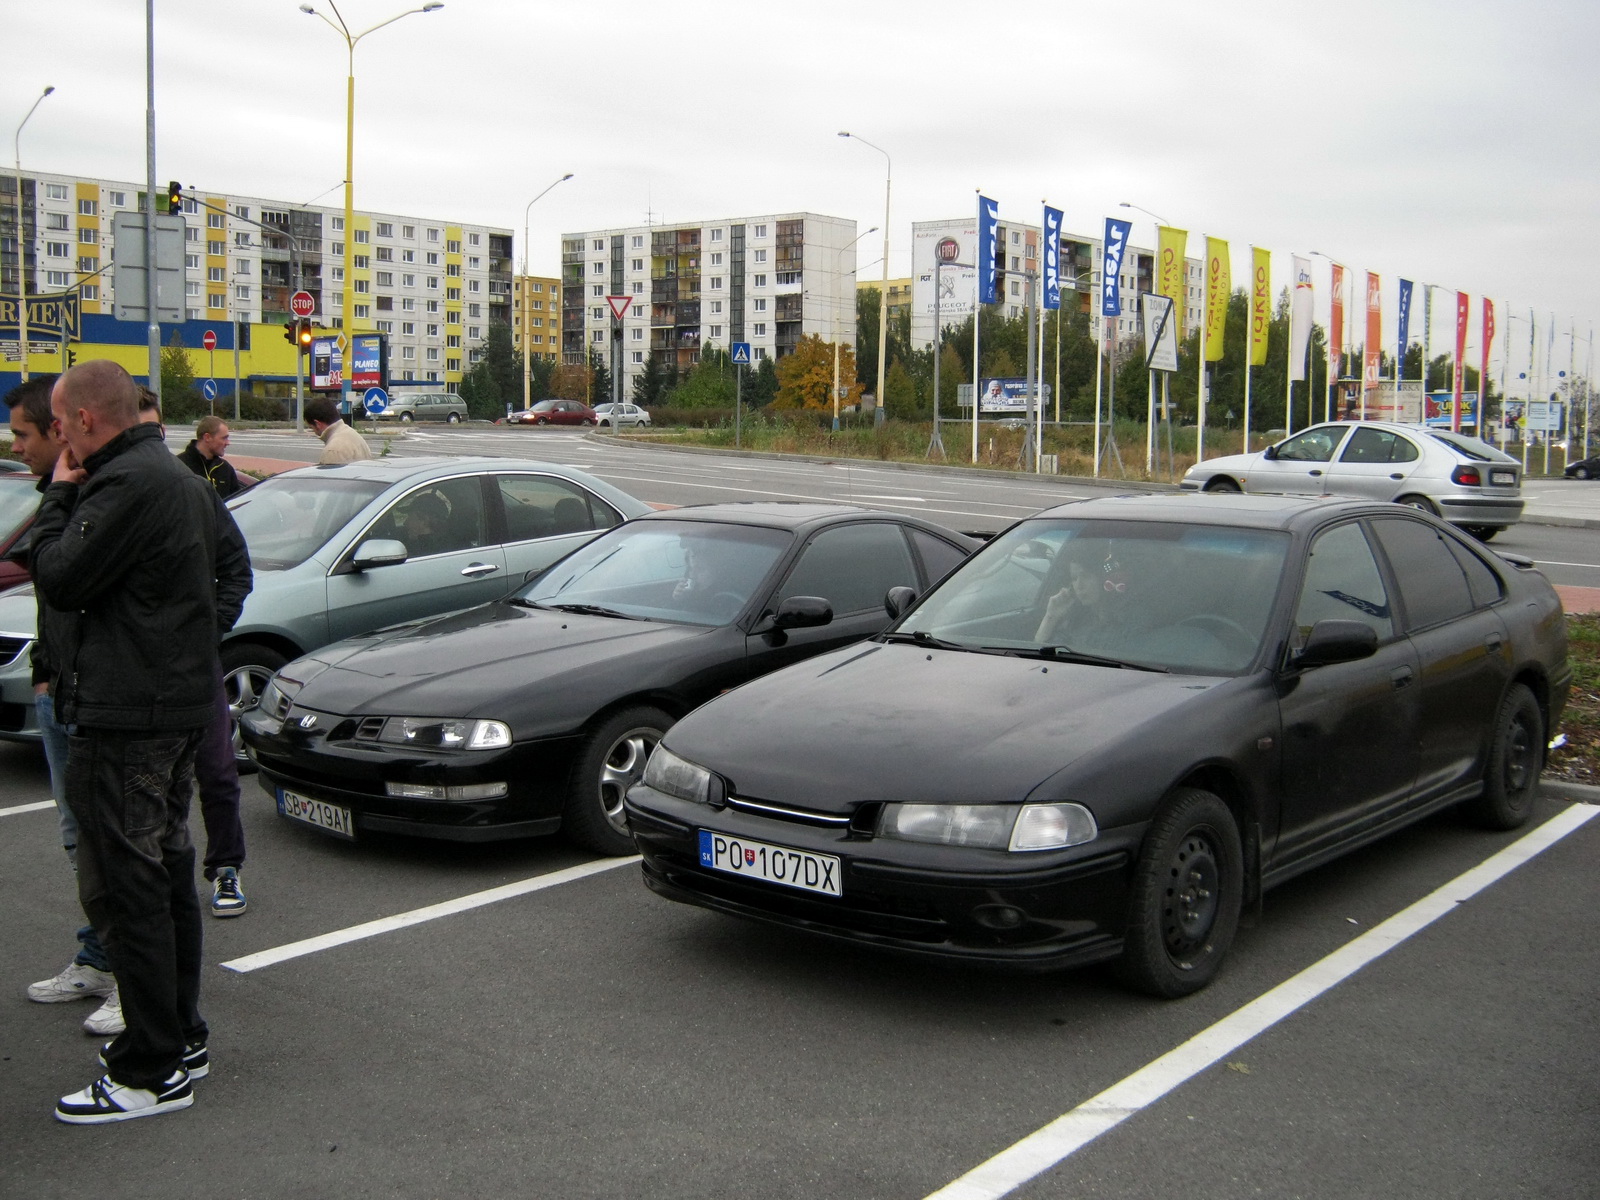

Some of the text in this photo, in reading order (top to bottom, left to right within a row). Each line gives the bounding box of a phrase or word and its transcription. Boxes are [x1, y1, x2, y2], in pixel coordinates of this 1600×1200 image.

[941, 244, 955, 258] FIAT
[1047, 212, 1058, 291] JYSK
[1105, 224, 1123, 298] JYSK
[293, 299, 312, 309] STOP
[354, 359, 379, 369] PLANEO
[284, 792, 350, 834] SB 219AY
[702, 852, 711, 861] SK
[714, 837, 836, 891] PO 107DX
